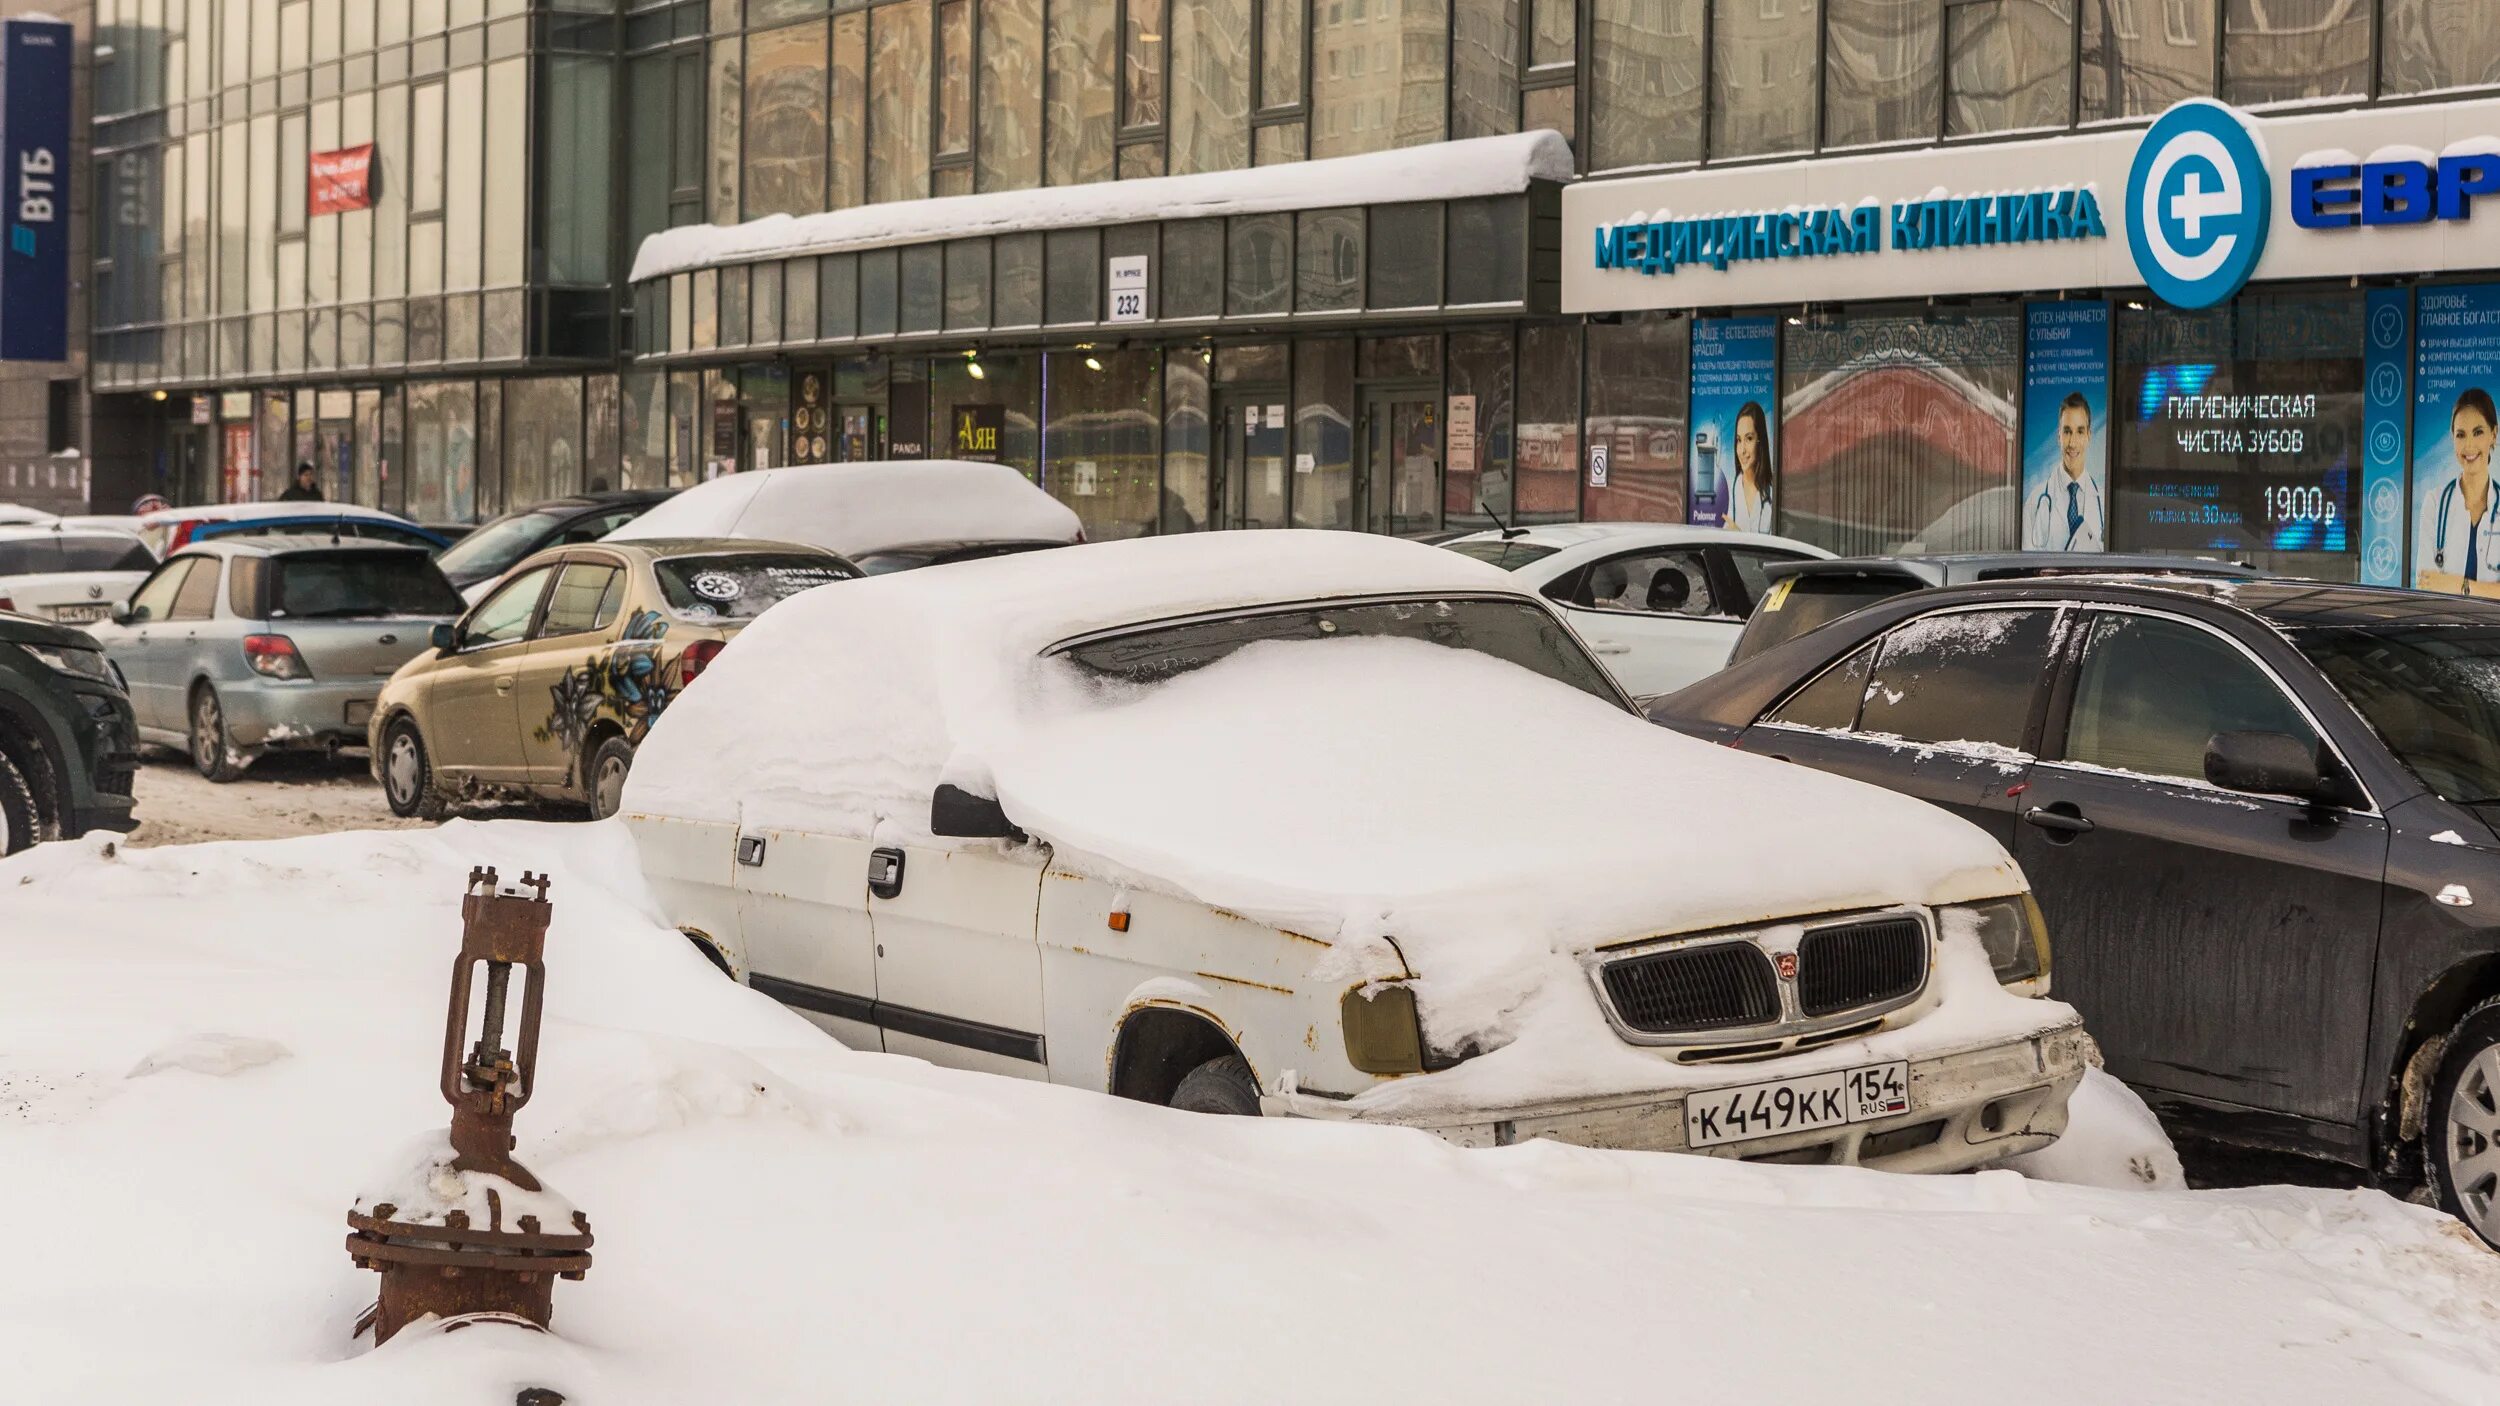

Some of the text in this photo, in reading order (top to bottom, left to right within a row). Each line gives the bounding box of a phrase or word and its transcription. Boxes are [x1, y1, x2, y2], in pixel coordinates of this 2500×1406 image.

[20, 147, 55, 222] ВТБ
[1595, 187, 2107, 275] МЕДИЦИНСКАЯ КЛИНИКА
[1117, 295, 1139, 315] 232
[2421, 295, 2467, 310] ЗДОРОВЬЕ
[2029, 308, 2106, 324] УСПЕХ НАЧИНАЕТСЯ
[2421, 312, 2461, 327] ГЛАВНОЕ
[2029, 328, 2035, 340] С
[2168, 394, 2315, 419] ГИГИЕНИЧЕСКАЯ
[893, 443, 922, 454] PANDA
[2177, 429, 2303, 452] ЧИСТКА ЗУБОВ
[1693, 510, 1716, 521] Palomar
[2202, 504, 2219, 524] 30
[766, 567, 826, 577] Детский
[1700, 1067, 1898, 1139] К449КК 154
[1860, 1101, 1886, 1116] RUS
